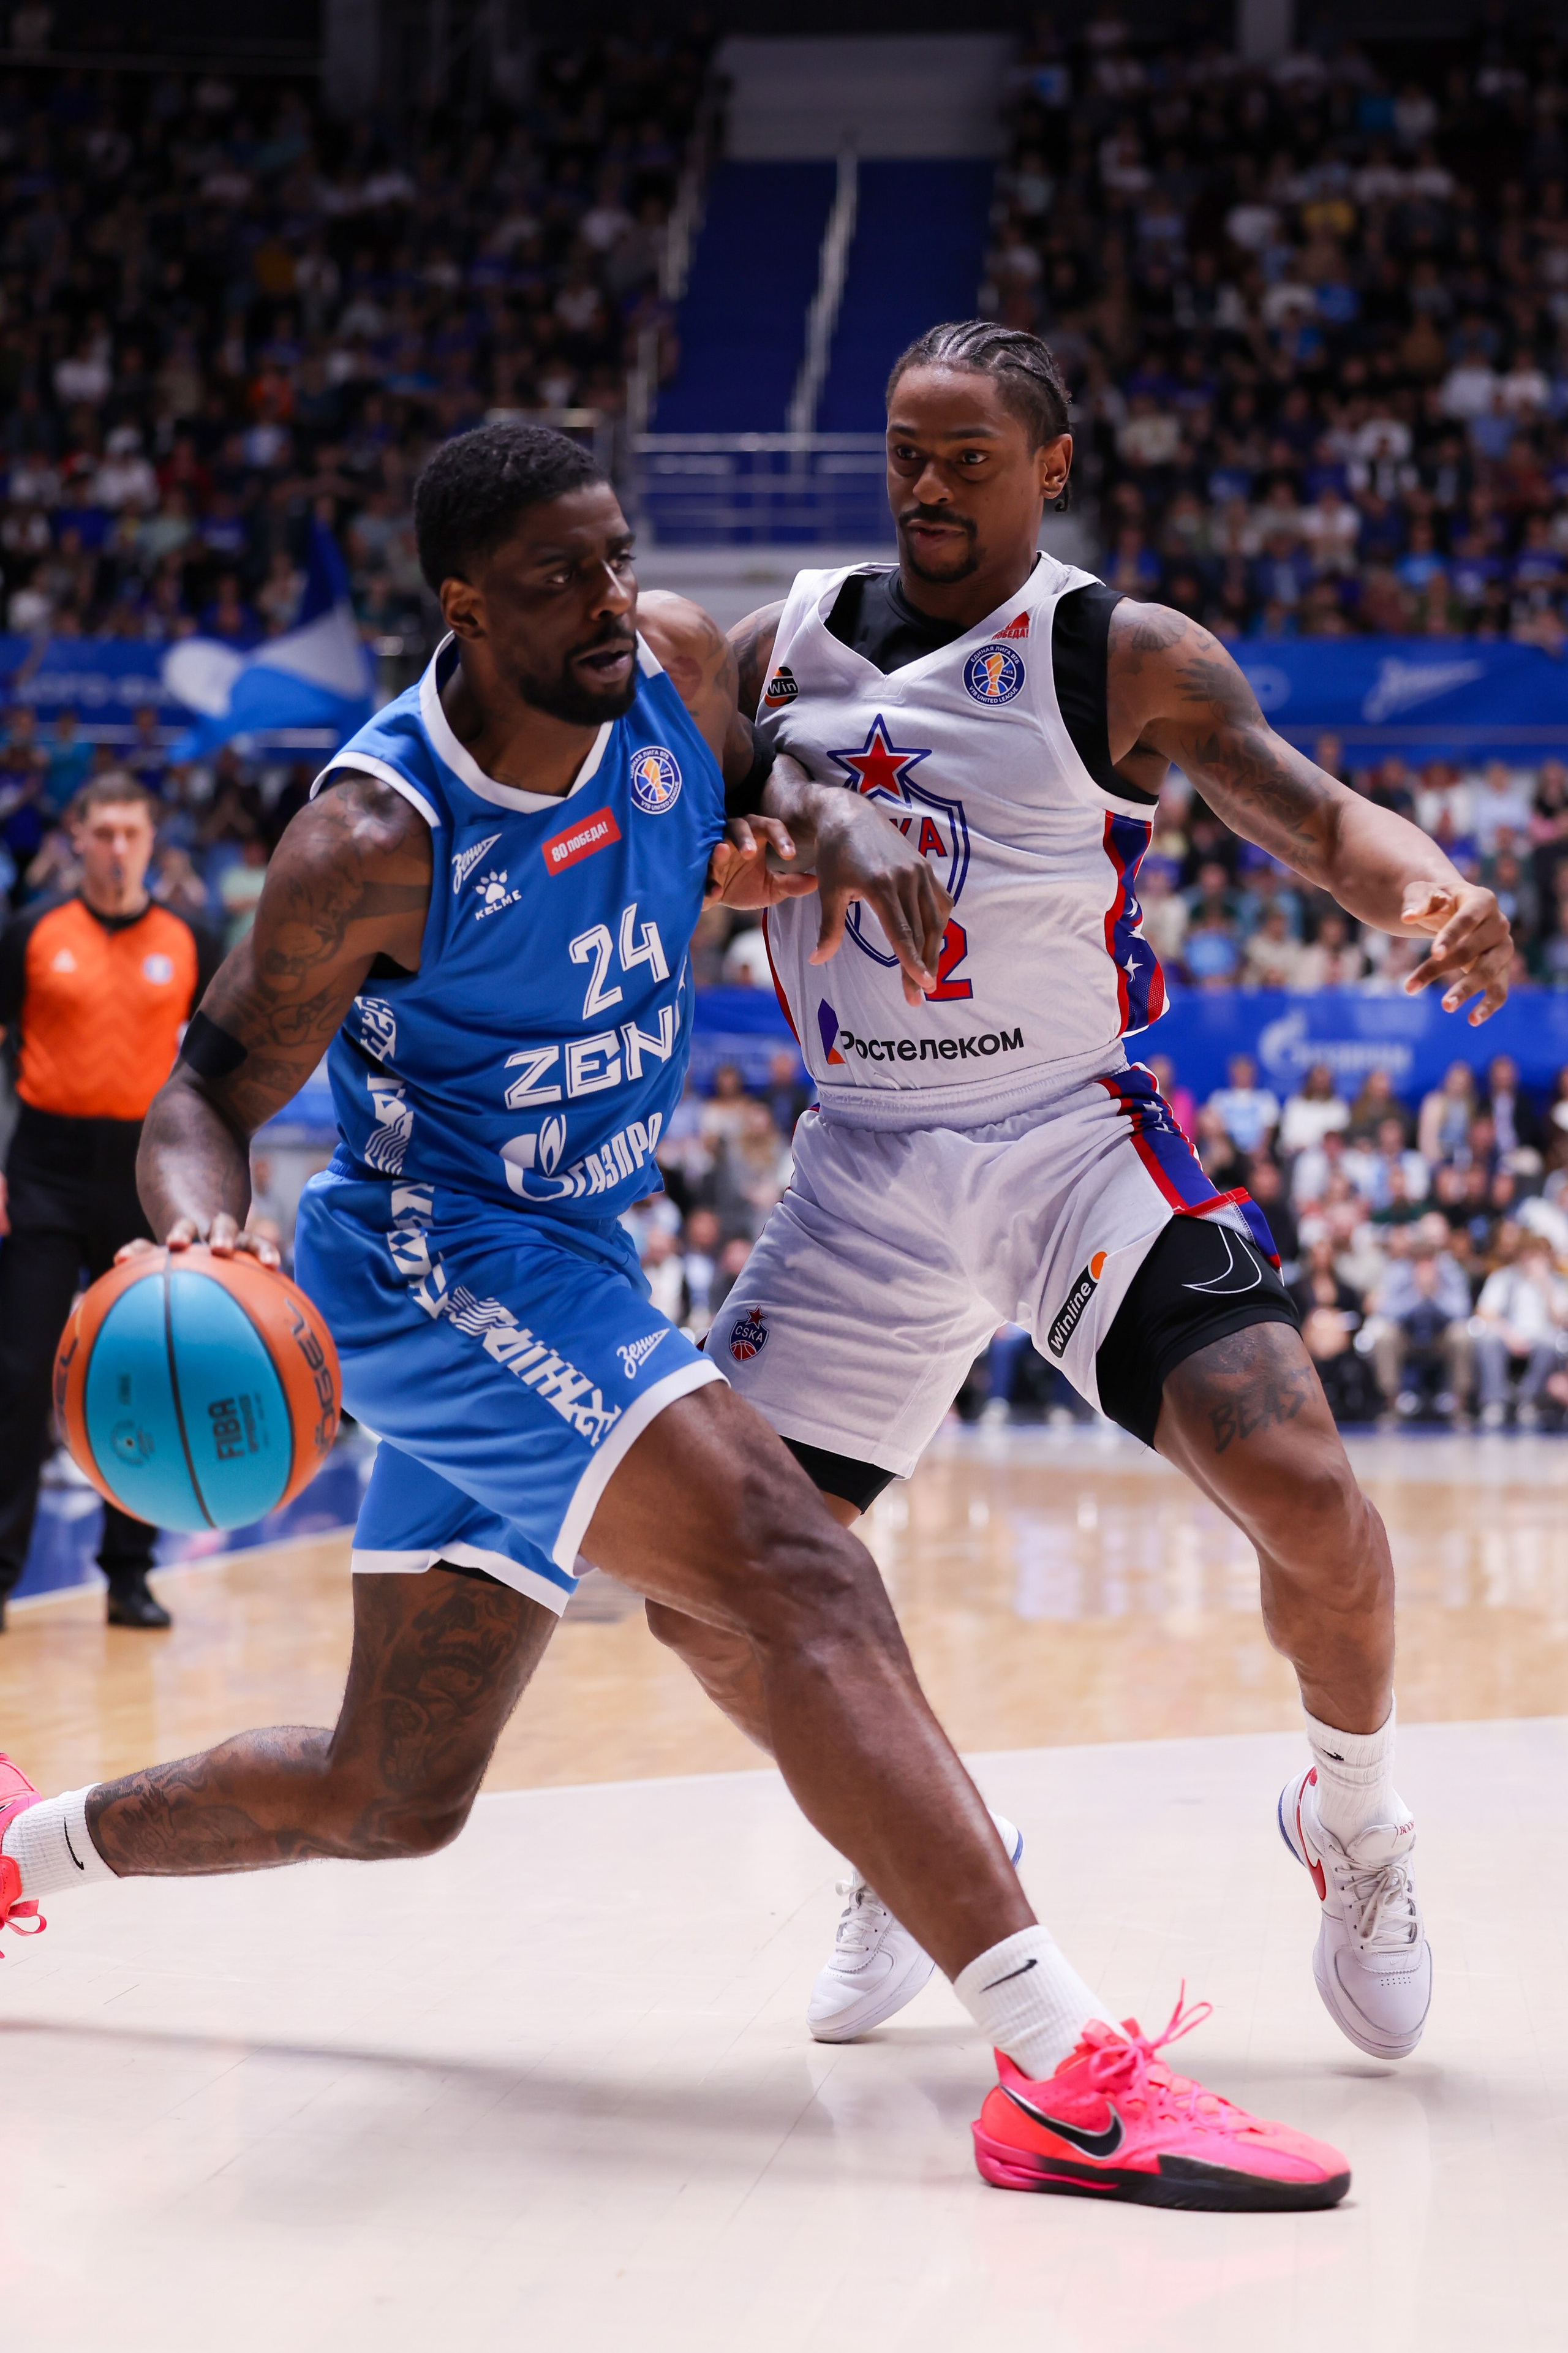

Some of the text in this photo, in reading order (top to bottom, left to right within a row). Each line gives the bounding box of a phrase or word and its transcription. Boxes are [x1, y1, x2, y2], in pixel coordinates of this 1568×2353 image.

[970, 646, 1020, 664] ЕДИНАЯ ЛИГА ВТБ
[769, 681, 797, 694] Win
[969, 686, 1018, 703] VTB UNITED LEAGUE
[643, 749, 659, 758] ЛИГА
[641, 800, 651, 809] VTB
[651, 801, 670, 810] UNITED
[551, 821, 609, 863] 80 ПОБЕДА!
[475, 889, 522, 921] KELME
[569, 903, 671, 1021] 24
[504, 1000, 680, 1110] ZEN
[840, 1027, 1025, 1062] Ростелеком
[570, 1112, 663, 1199] ГАЗПРО
[1050, 1281, 1091, 1351] Winline
[735, 1326, 763, 1343] CSKA
[208, 1397, 244, 1460] FIBA
